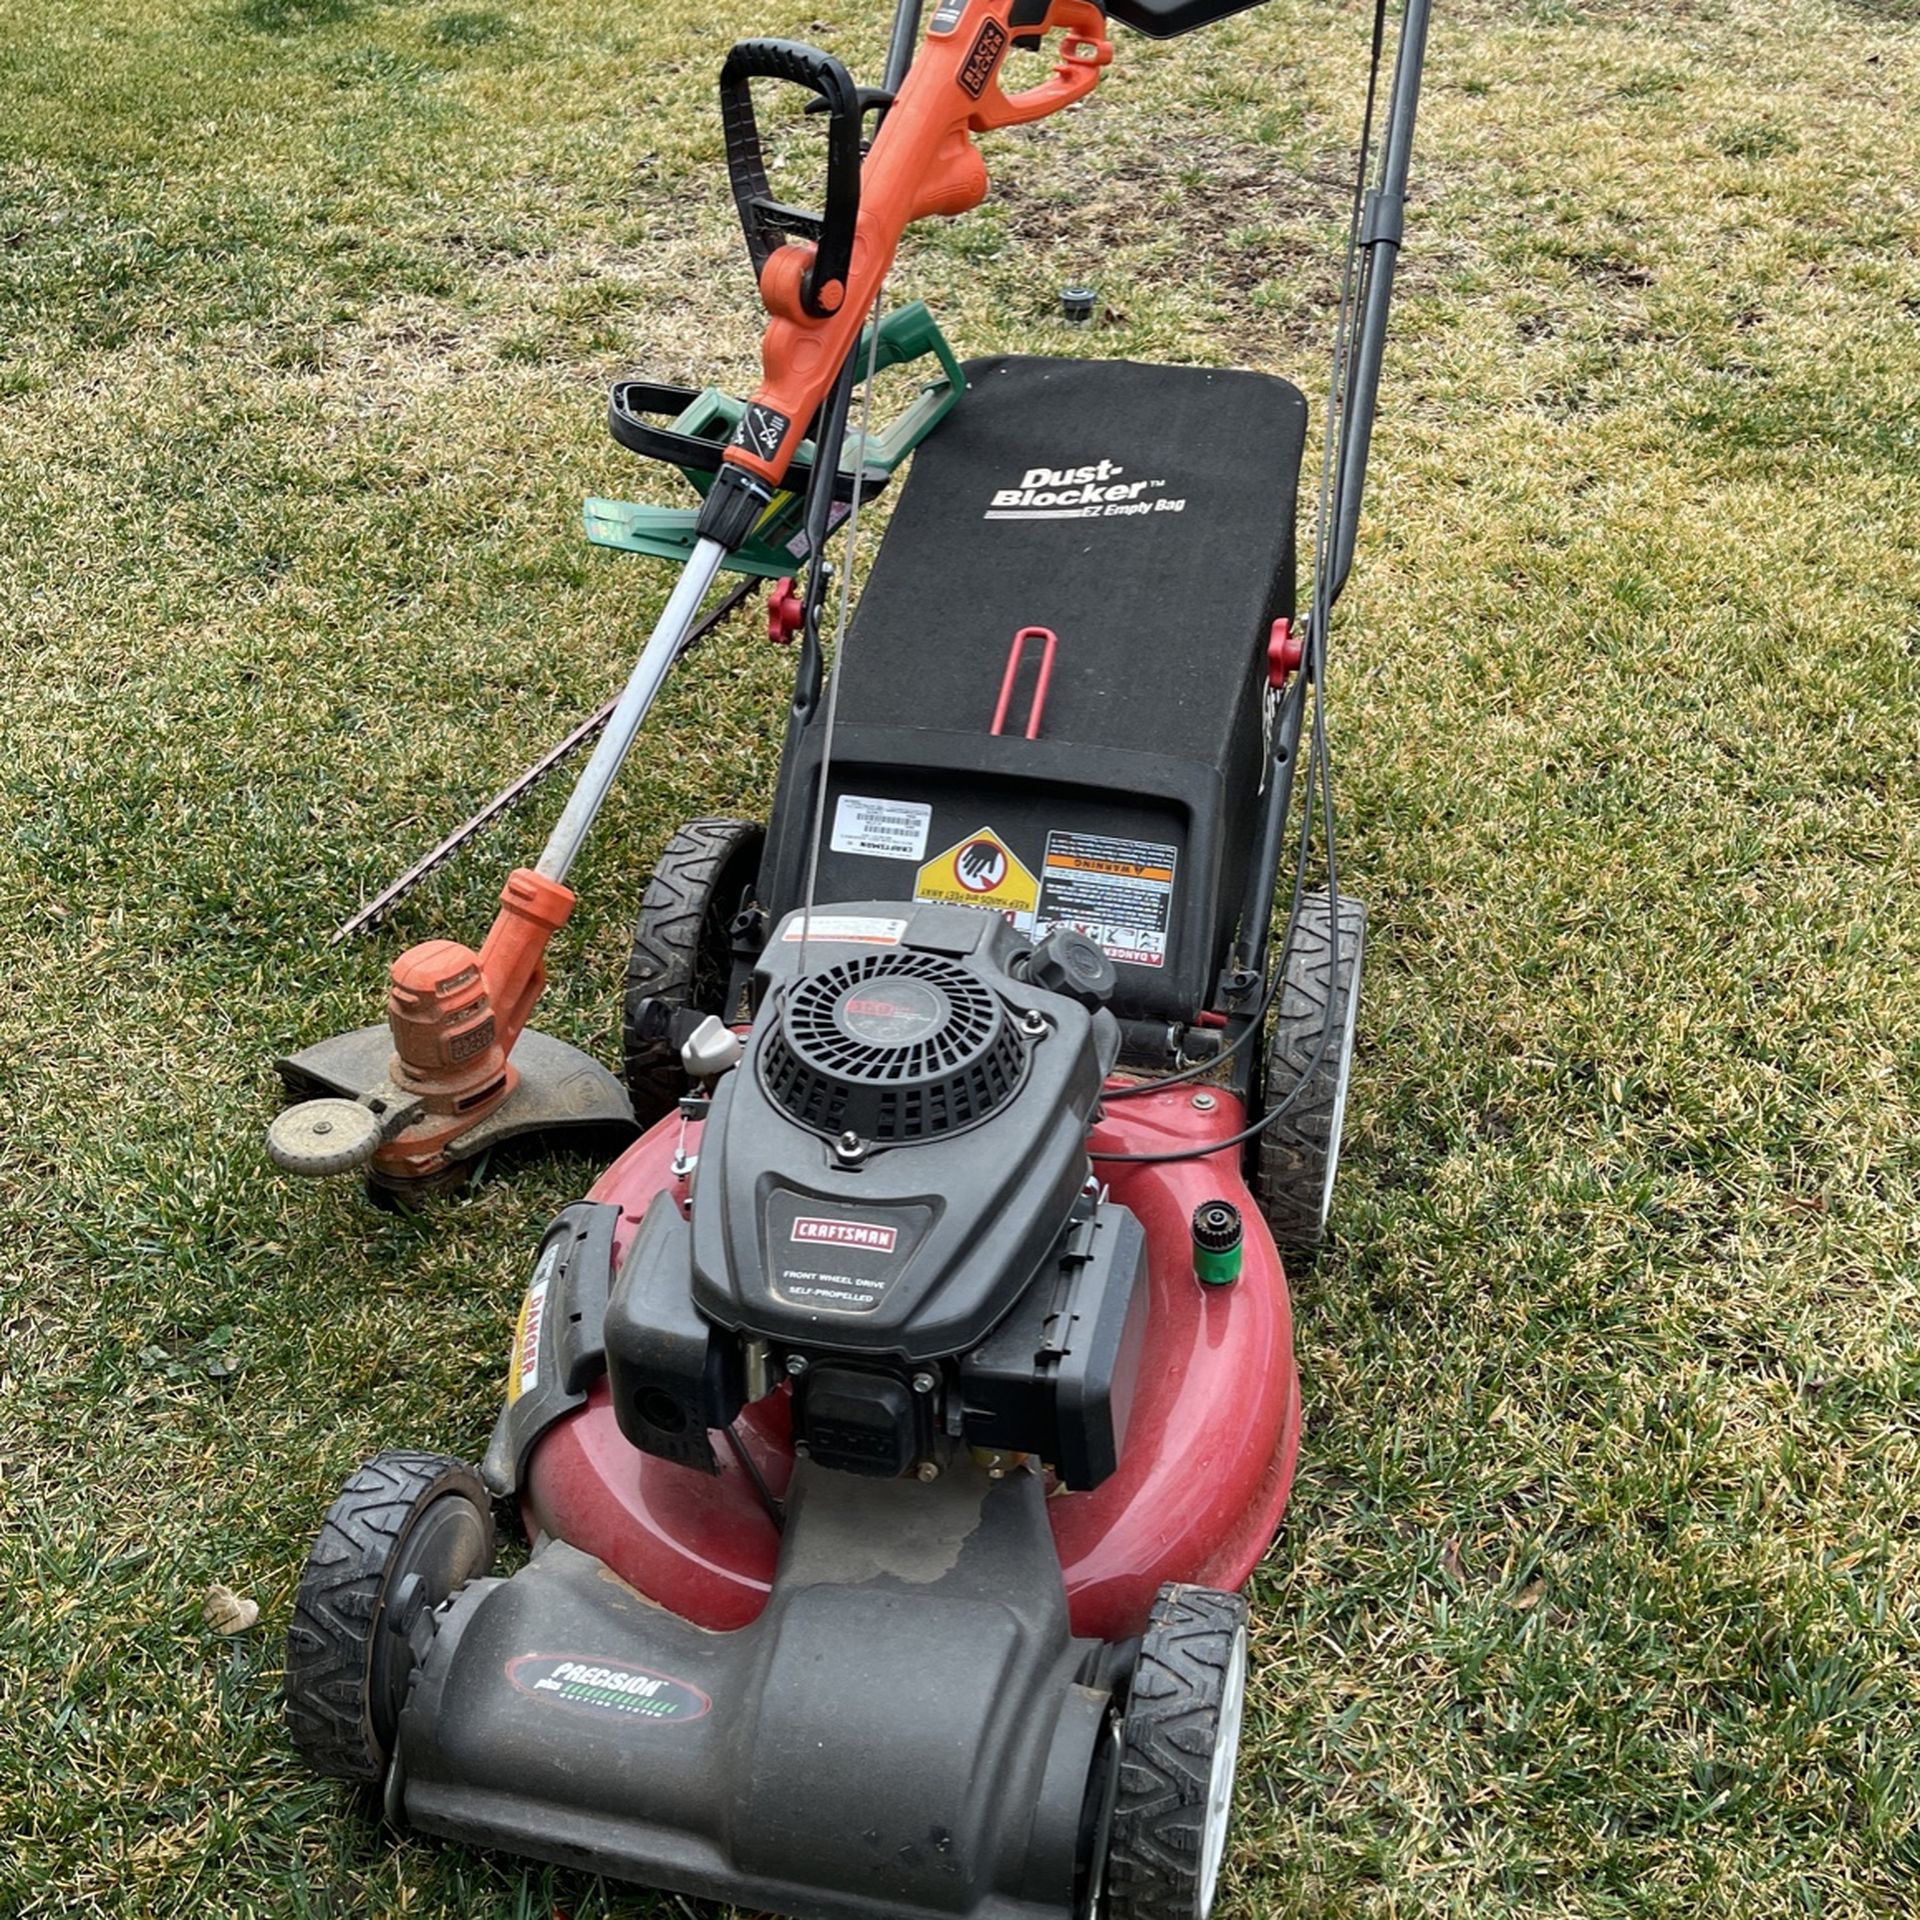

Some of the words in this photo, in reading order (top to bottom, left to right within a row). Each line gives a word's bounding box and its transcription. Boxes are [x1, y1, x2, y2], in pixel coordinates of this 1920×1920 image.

[971, 34, 1003, 90] DECKER
[1019, 459, 1123, 489] Dust-
[990, 481, 1148, 506] Blocker
[1082, 505, 1103, 518] EZ
[1103, 502, 1153, 516] Empty
[1154, 499, 1186, 511] Bag
[1074, 859, 1130, 873] WARNING
[980, 895, 1007, 905] HANDS
[1009, 901, 1030, 909] KEEP
[798, 1223, 890, 1246] CRAFTSMAN
[783, 1270, 818, 1281] FRONT
[819, 1273, 853, 1286] WHEEL
[855, 1278, 886, 1290] DRIVE
[788, 1286, 874, 1303] SELF-PROPELLED
[522, 1295, 544, 1375] DANGER
[551, 1662, 662, 1697] PRECISION
